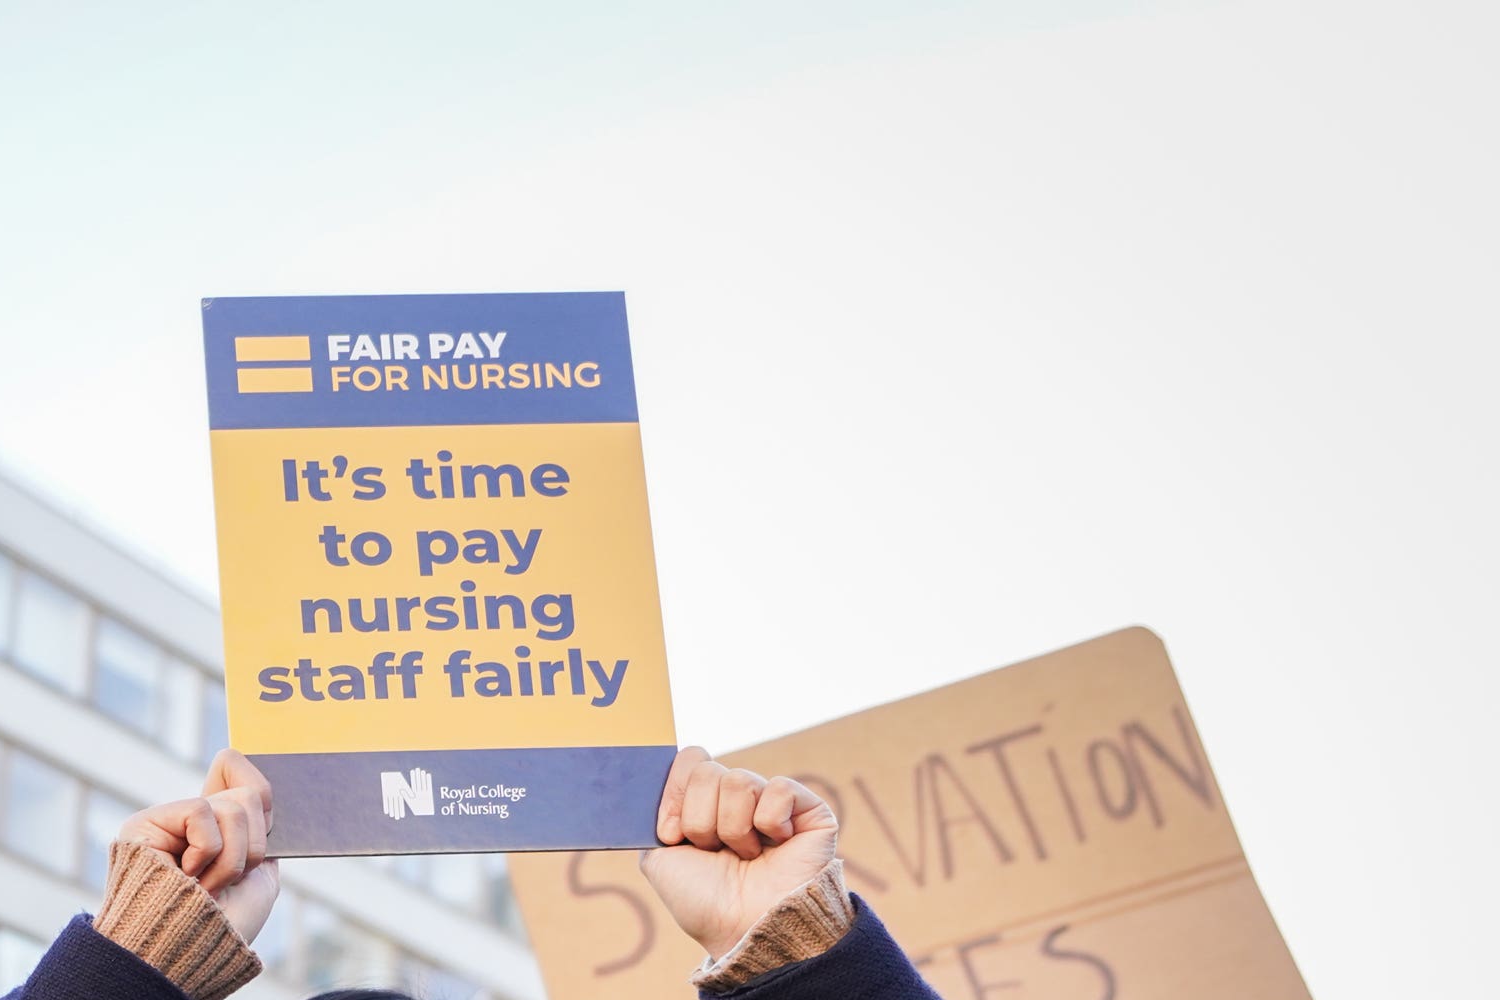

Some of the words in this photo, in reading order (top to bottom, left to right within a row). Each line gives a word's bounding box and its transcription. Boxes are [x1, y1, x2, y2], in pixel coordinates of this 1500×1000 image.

[328, 333, 420, 361] FAIR
[429, 332, 507, 360] PAY
[331, 366, 410, 392] FOR
[422, 362, 601, 391] NURSING
[282, 454, 387, 502] It’s
[406, 450, 571, 500] time
[318, 525, 393, 567] to
[416, 528, 543, 577] pay
[300, 580, 575, 641] nursing
[257, 650, 424, 702] staff
[444, 645, 630, 708] fairly
[440, 785, 475, 803] Royal
[478, 784, 527, 803] College
[441, 801, 457, 816] of
[459, 801, 510, 819] Nursing
